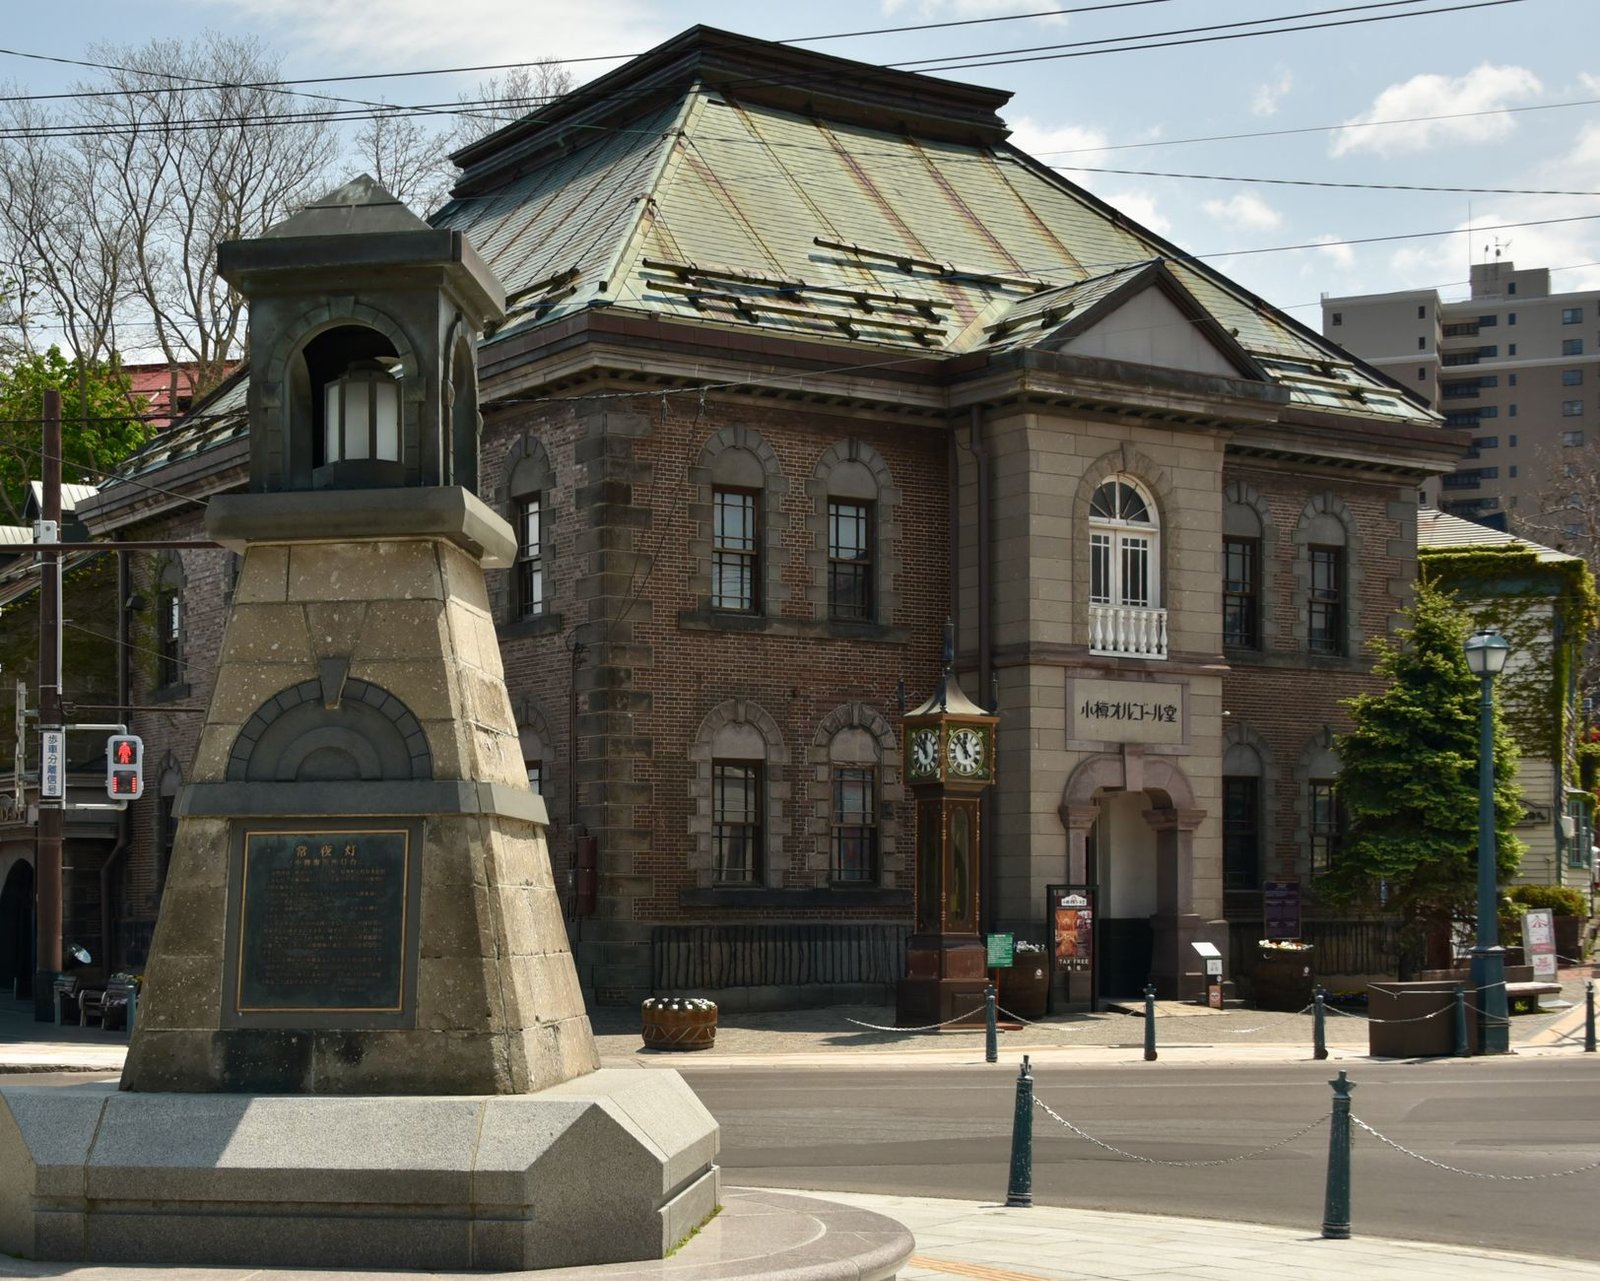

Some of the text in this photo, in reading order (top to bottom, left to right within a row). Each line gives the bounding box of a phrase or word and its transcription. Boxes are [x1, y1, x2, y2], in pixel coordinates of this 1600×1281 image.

[1080, 700, 1178, 723] 小樽オルゴール堂
[47, 734, 58, 795] 歩車分離信号
